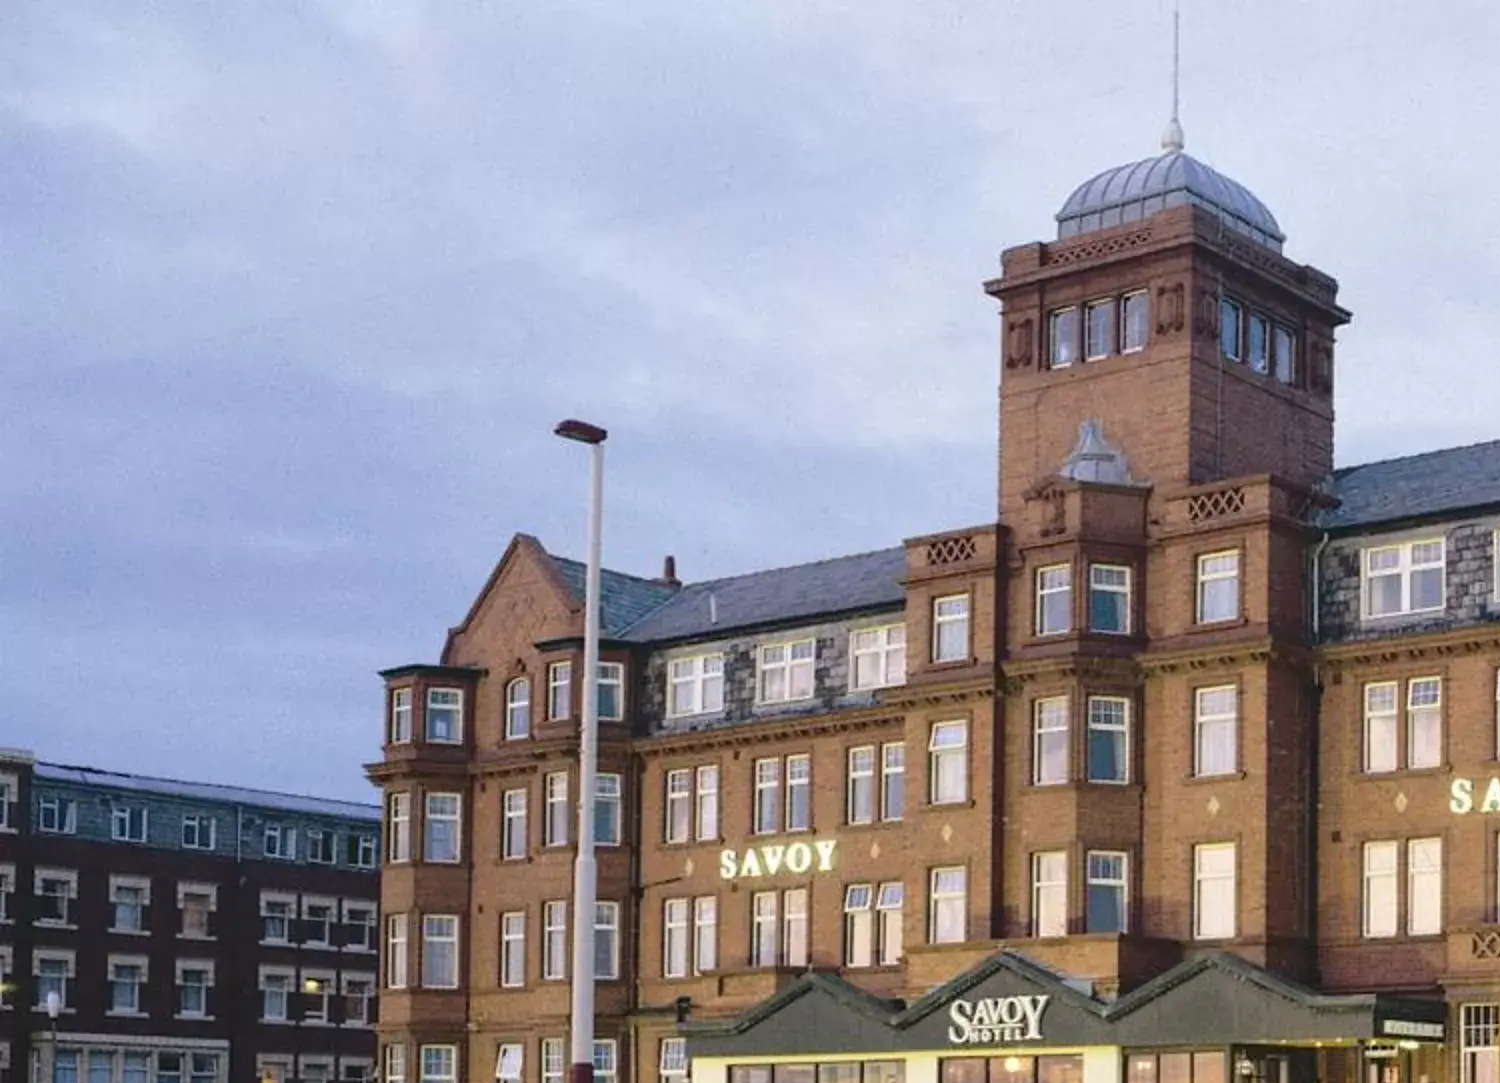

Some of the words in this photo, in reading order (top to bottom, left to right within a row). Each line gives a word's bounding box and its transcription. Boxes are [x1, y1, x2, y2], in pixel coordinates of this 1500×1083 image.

[720, 840, 837, 879] SAVOY
[948, 995, 1050, 1043] SAVOY
[969, 1027, 1024, 1043] HOTEL
